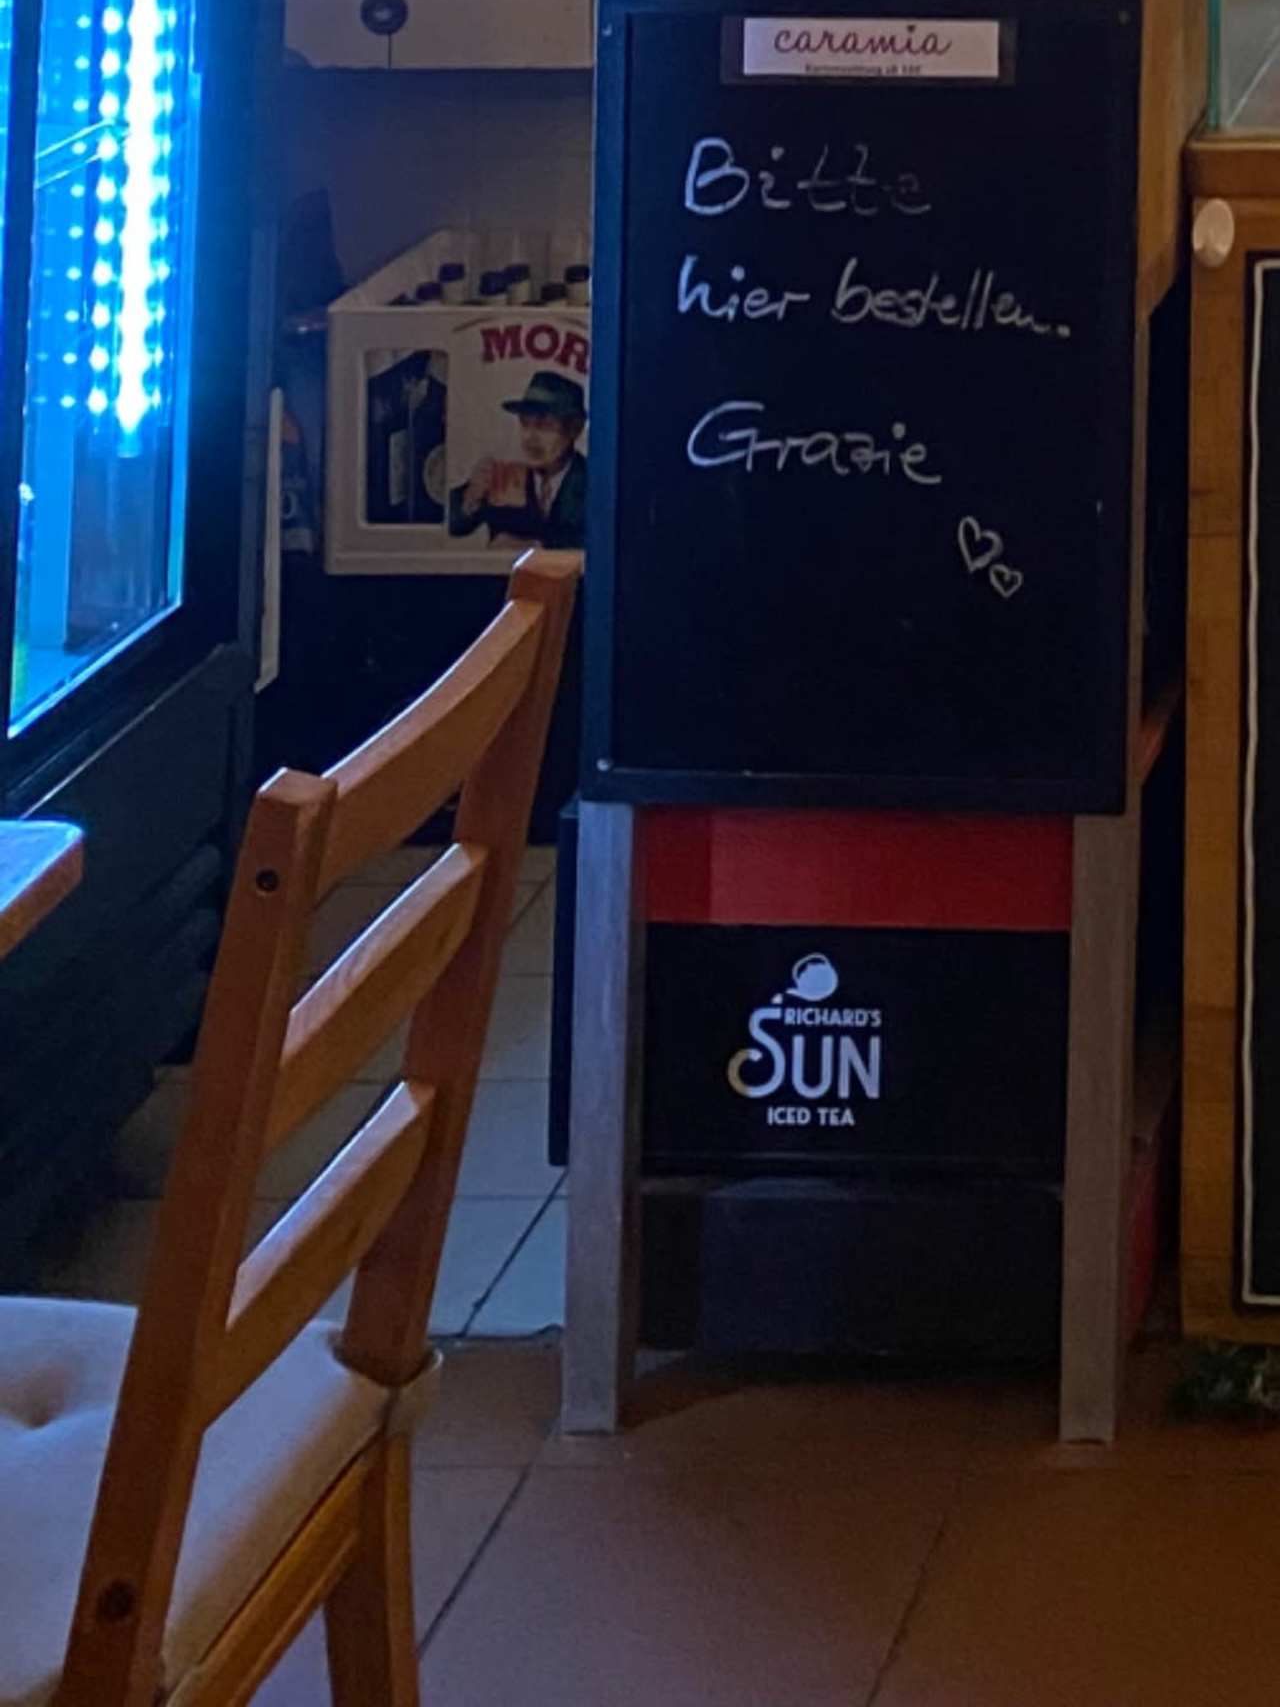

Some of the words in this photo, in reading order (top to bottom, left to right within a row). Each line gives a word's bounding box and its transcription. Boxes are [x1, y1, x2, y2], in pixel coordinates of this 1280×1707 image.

[774, 25, 952, 57] caramia
[684, 137, 932, 215] Bitte
[676, 254, 810, 321] hier
[685, 400, 942, 484] Grazie
[783, 1007, 881, 1027] RICHARD'S
[729, 1006, 881, 1099] SUN
[767, 1106, 812, 1126] ICED
[816, 1107, 855, 1126] TEA
